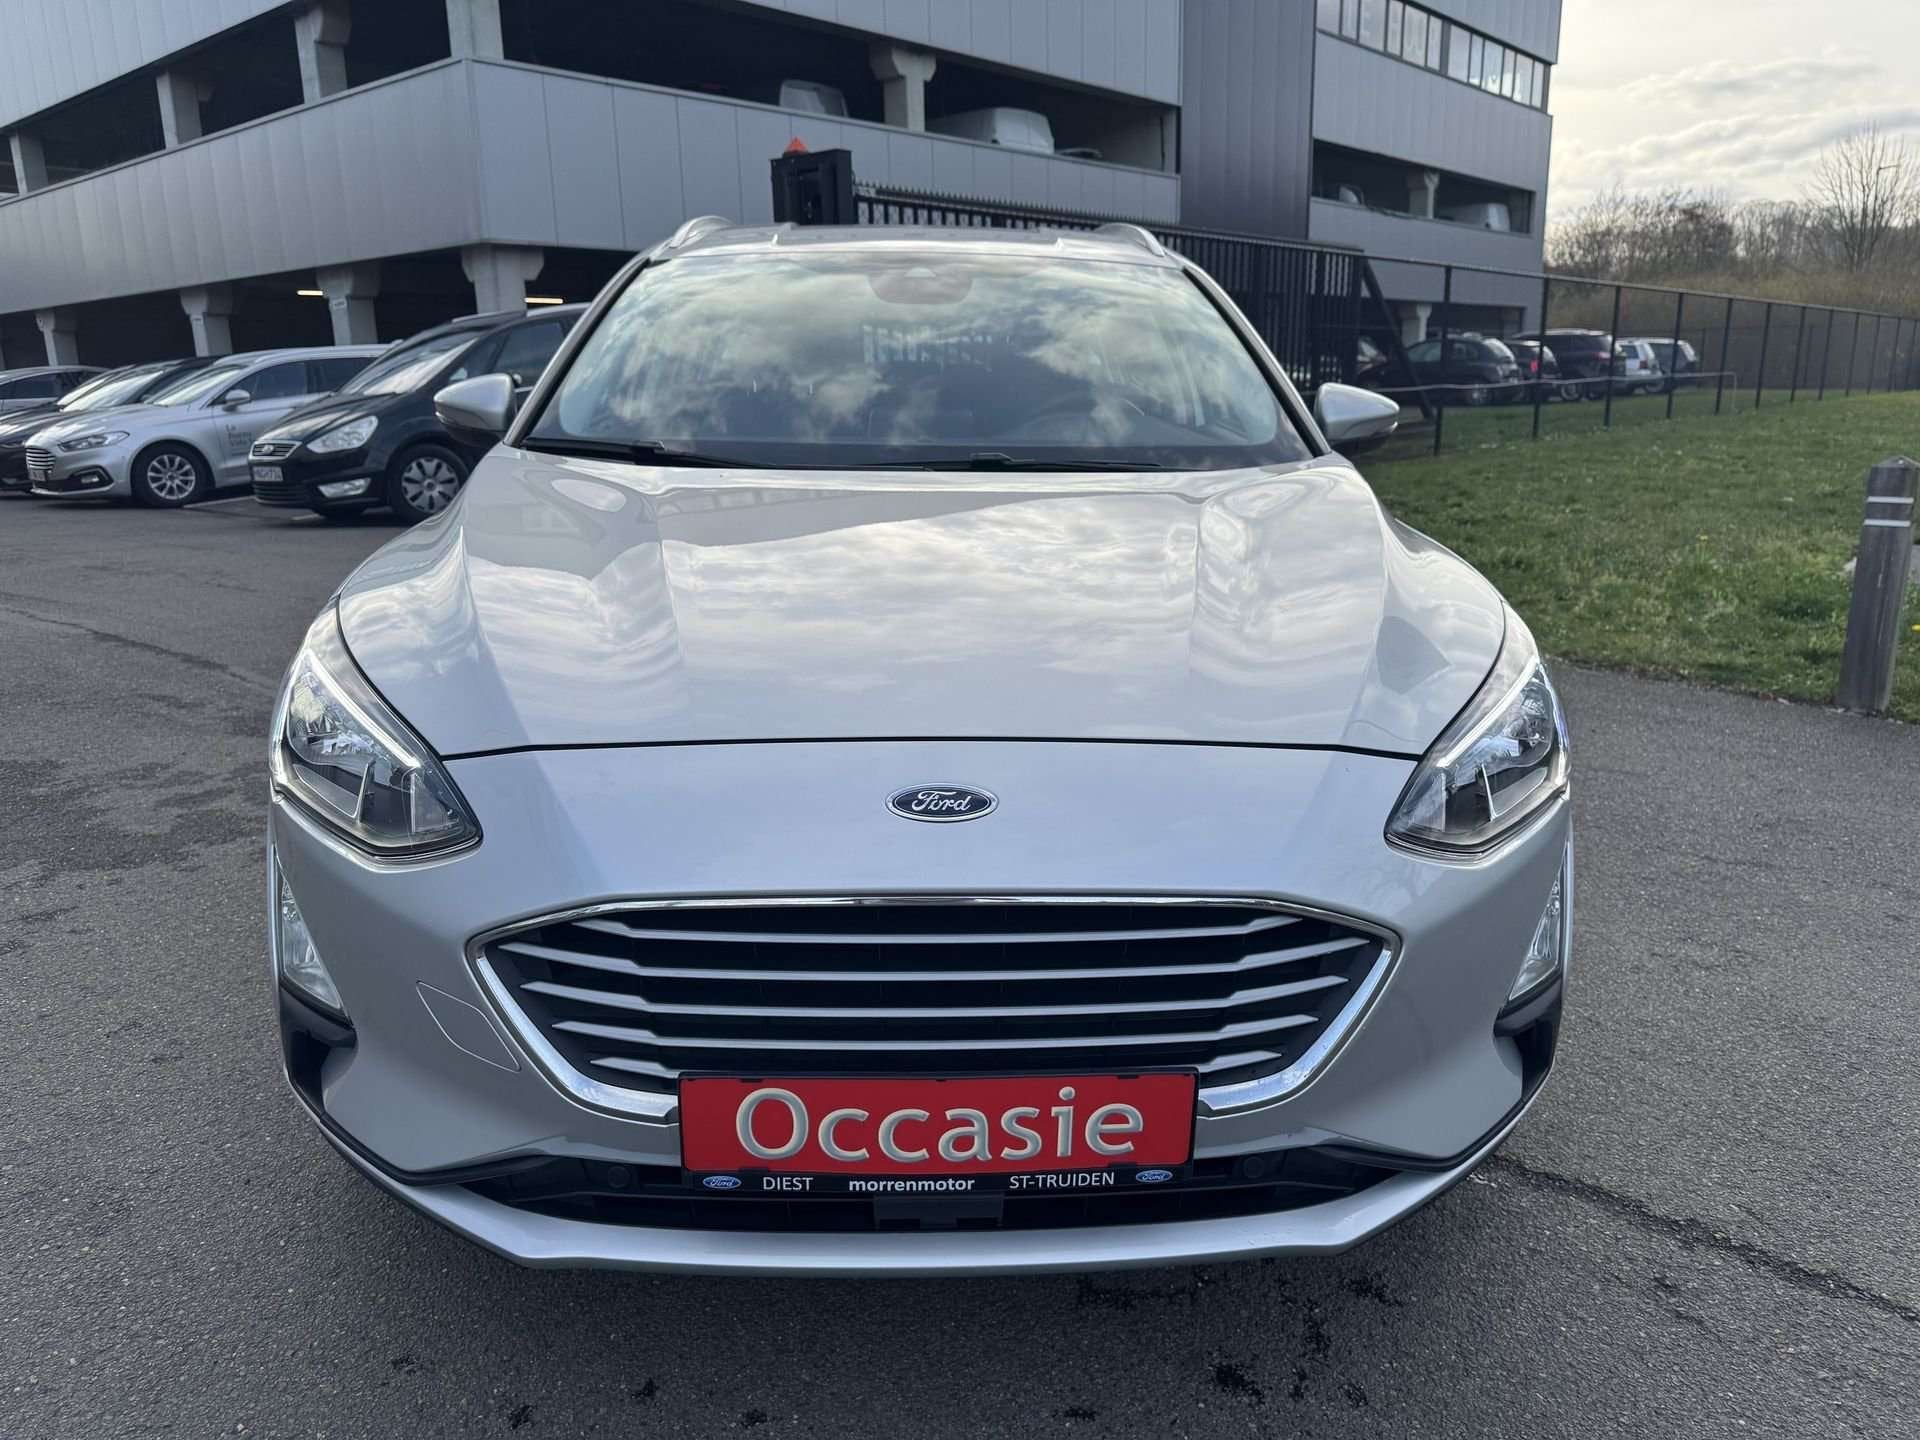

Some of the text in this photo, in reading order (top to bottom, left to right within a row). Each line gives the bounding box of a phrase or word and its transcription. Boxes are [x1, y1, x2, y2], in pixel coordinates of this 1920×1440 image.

[912, 790, 972, 811] Ford
[735, 1086, 1144, 1163] Occasie
[762, 1176, 814, 1191] DIEST
[848, 1179, 976, 1192] morrenmotor
[1009, 1172, 1115, 1189] ST-TRUIDEN
